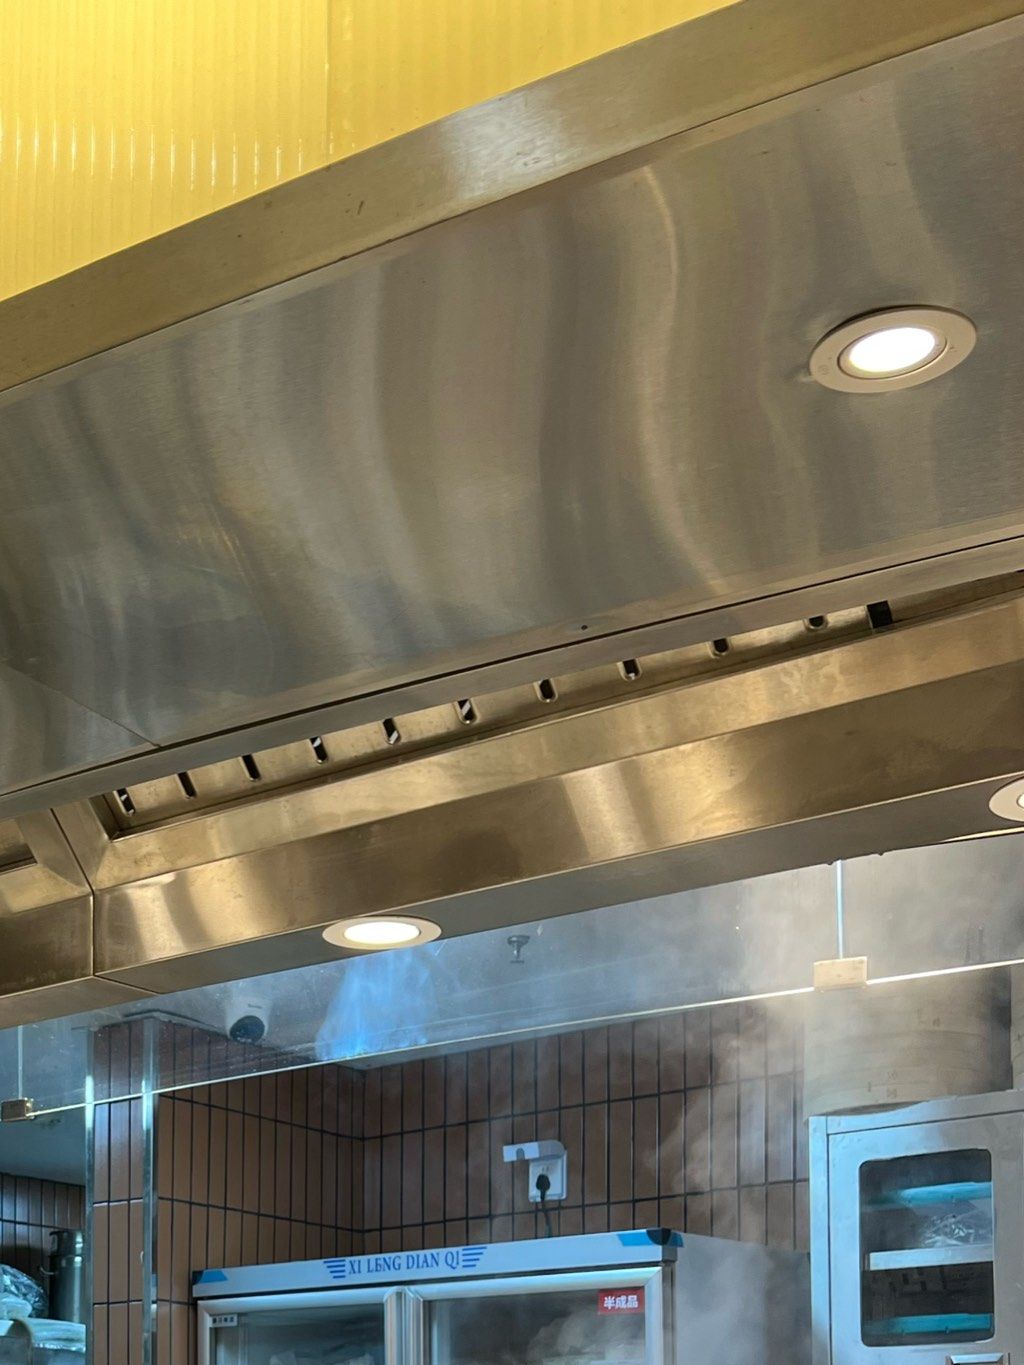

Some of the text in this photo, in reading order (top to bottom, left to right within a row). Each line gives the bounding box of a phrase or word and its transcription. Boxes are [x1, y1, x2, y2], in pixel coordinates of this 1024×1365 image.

[348, 1260, 361, 1275] XI
[406, 1252, 440, 1270] DIAN
[445, 1250, 459, 1270] QI
[603, 1295, 638, 1310] 半成品
